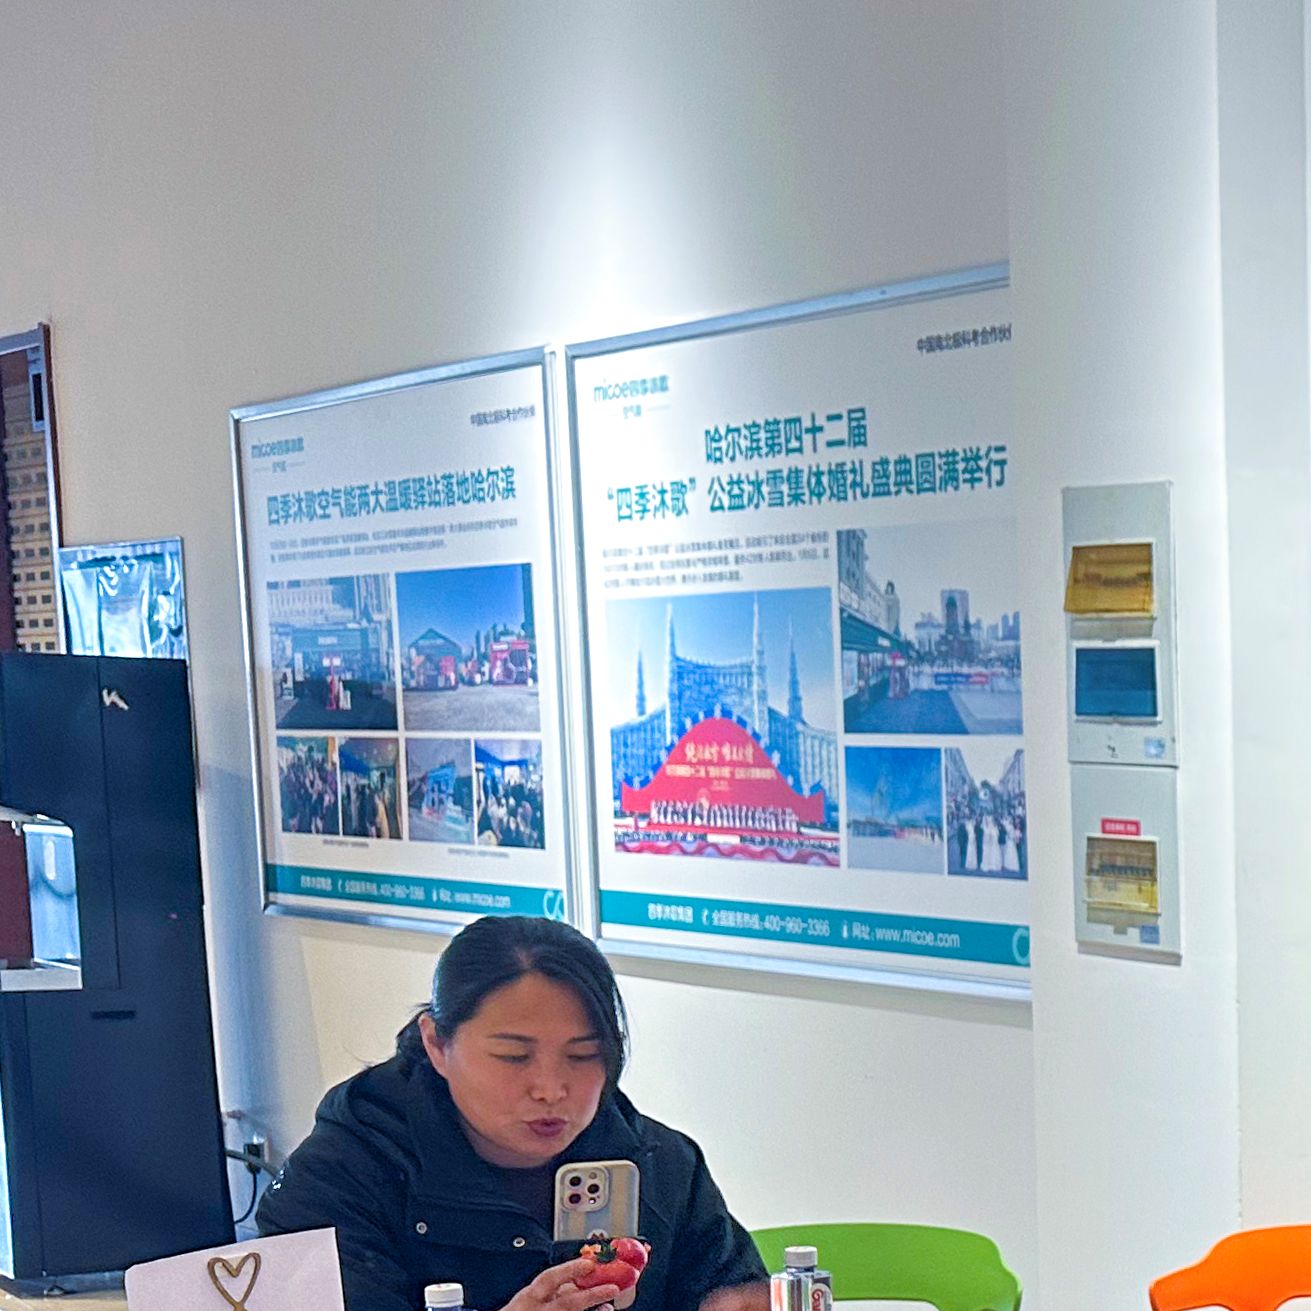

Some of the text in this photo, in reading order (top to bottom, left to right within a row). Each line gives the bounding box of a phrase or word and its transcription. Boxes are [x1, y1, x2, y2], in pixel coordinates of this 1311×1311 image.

[705, 407, 868, 464] 哈尔滨第四十二届
[267, 465, 517, 526] 四季沐歌空气能两大温暖驿站落地哈尔滨
